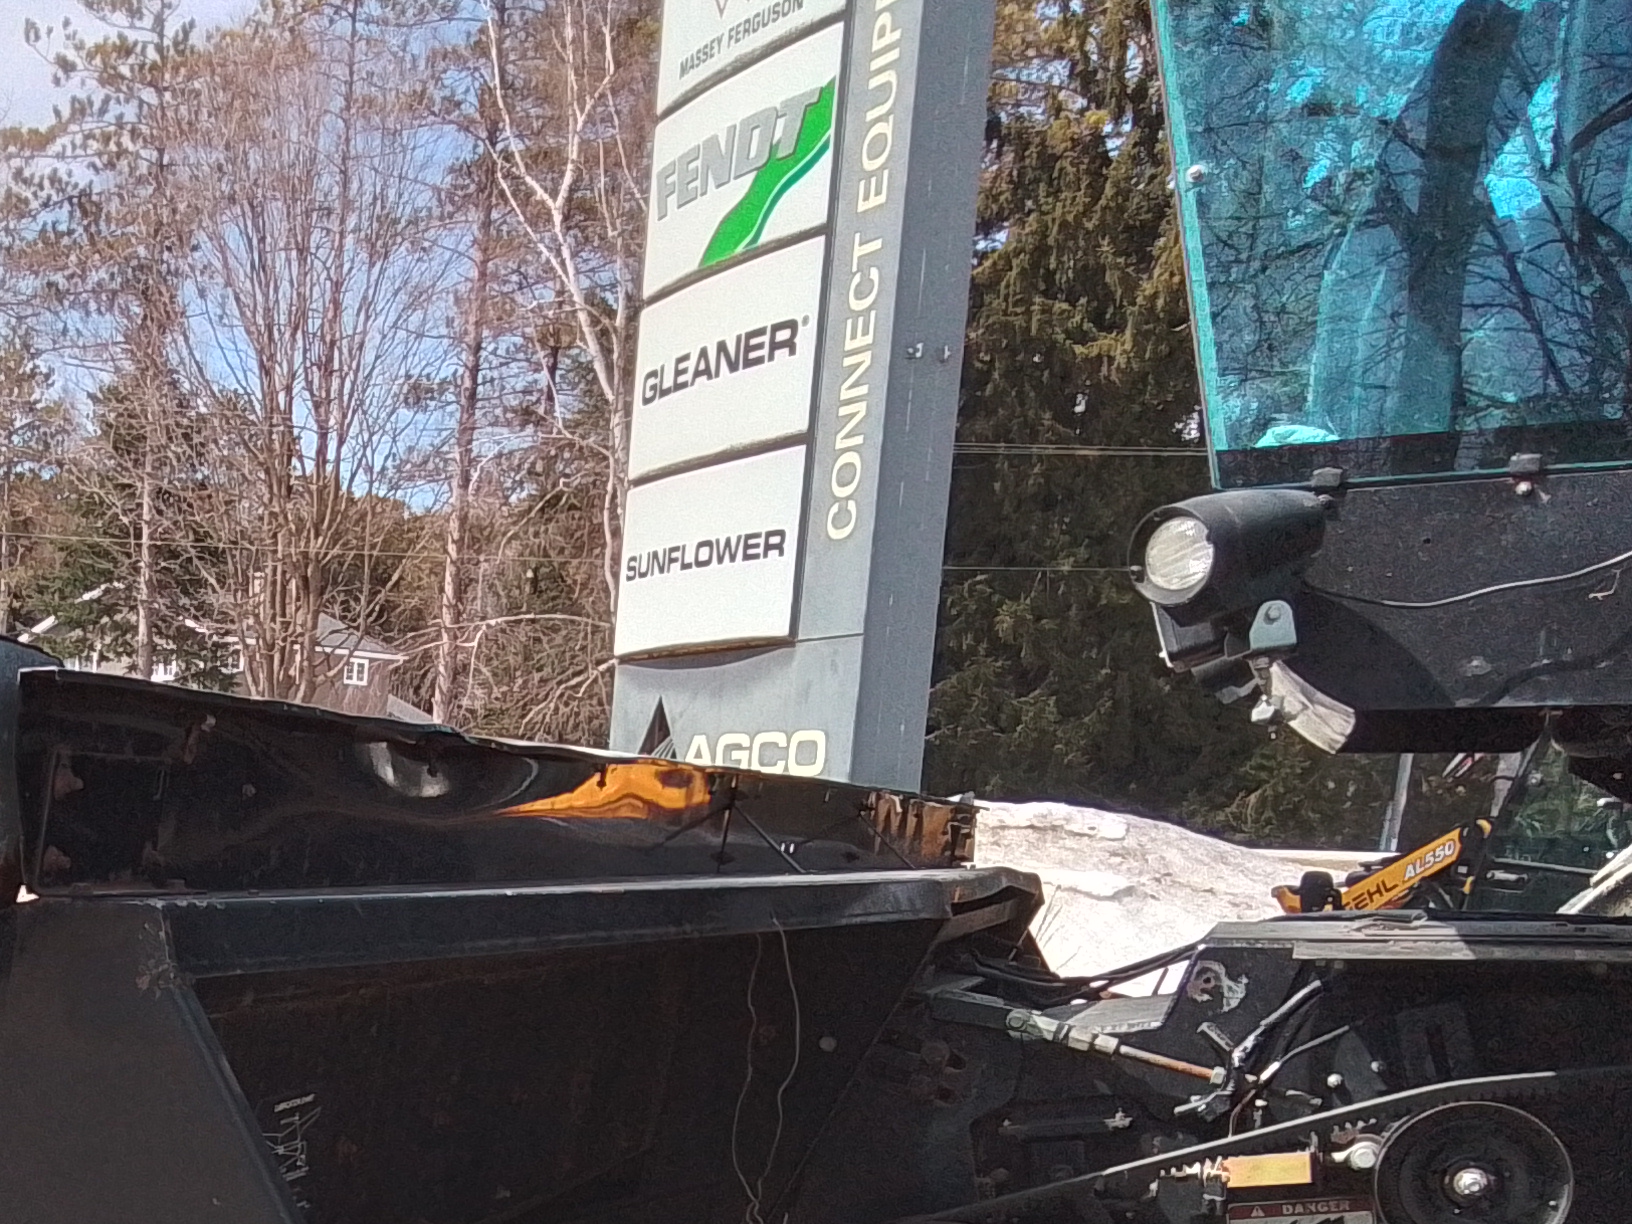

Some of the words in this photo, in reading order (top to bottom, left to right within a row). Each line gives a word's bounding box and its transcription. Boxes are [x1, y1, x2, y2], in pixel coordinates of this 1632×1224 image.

[678, 32, 724, 80] MASSEY
[726, 0, 804, 49] FERGUSON
[655, 86, 823, 222] FENDT
[826, 232, 883, 541] CONNECT
[857, 0, 902, 214] EQUIP
[641, 318, 799, 407] GLEANER
[625, 529, 787, 582] SUNFLOWER
[684, 729, 827, 777] AGCO
[1403, 840, 1455, 881] AL550
[1282, 1201, 1350, 1215] DANGER
